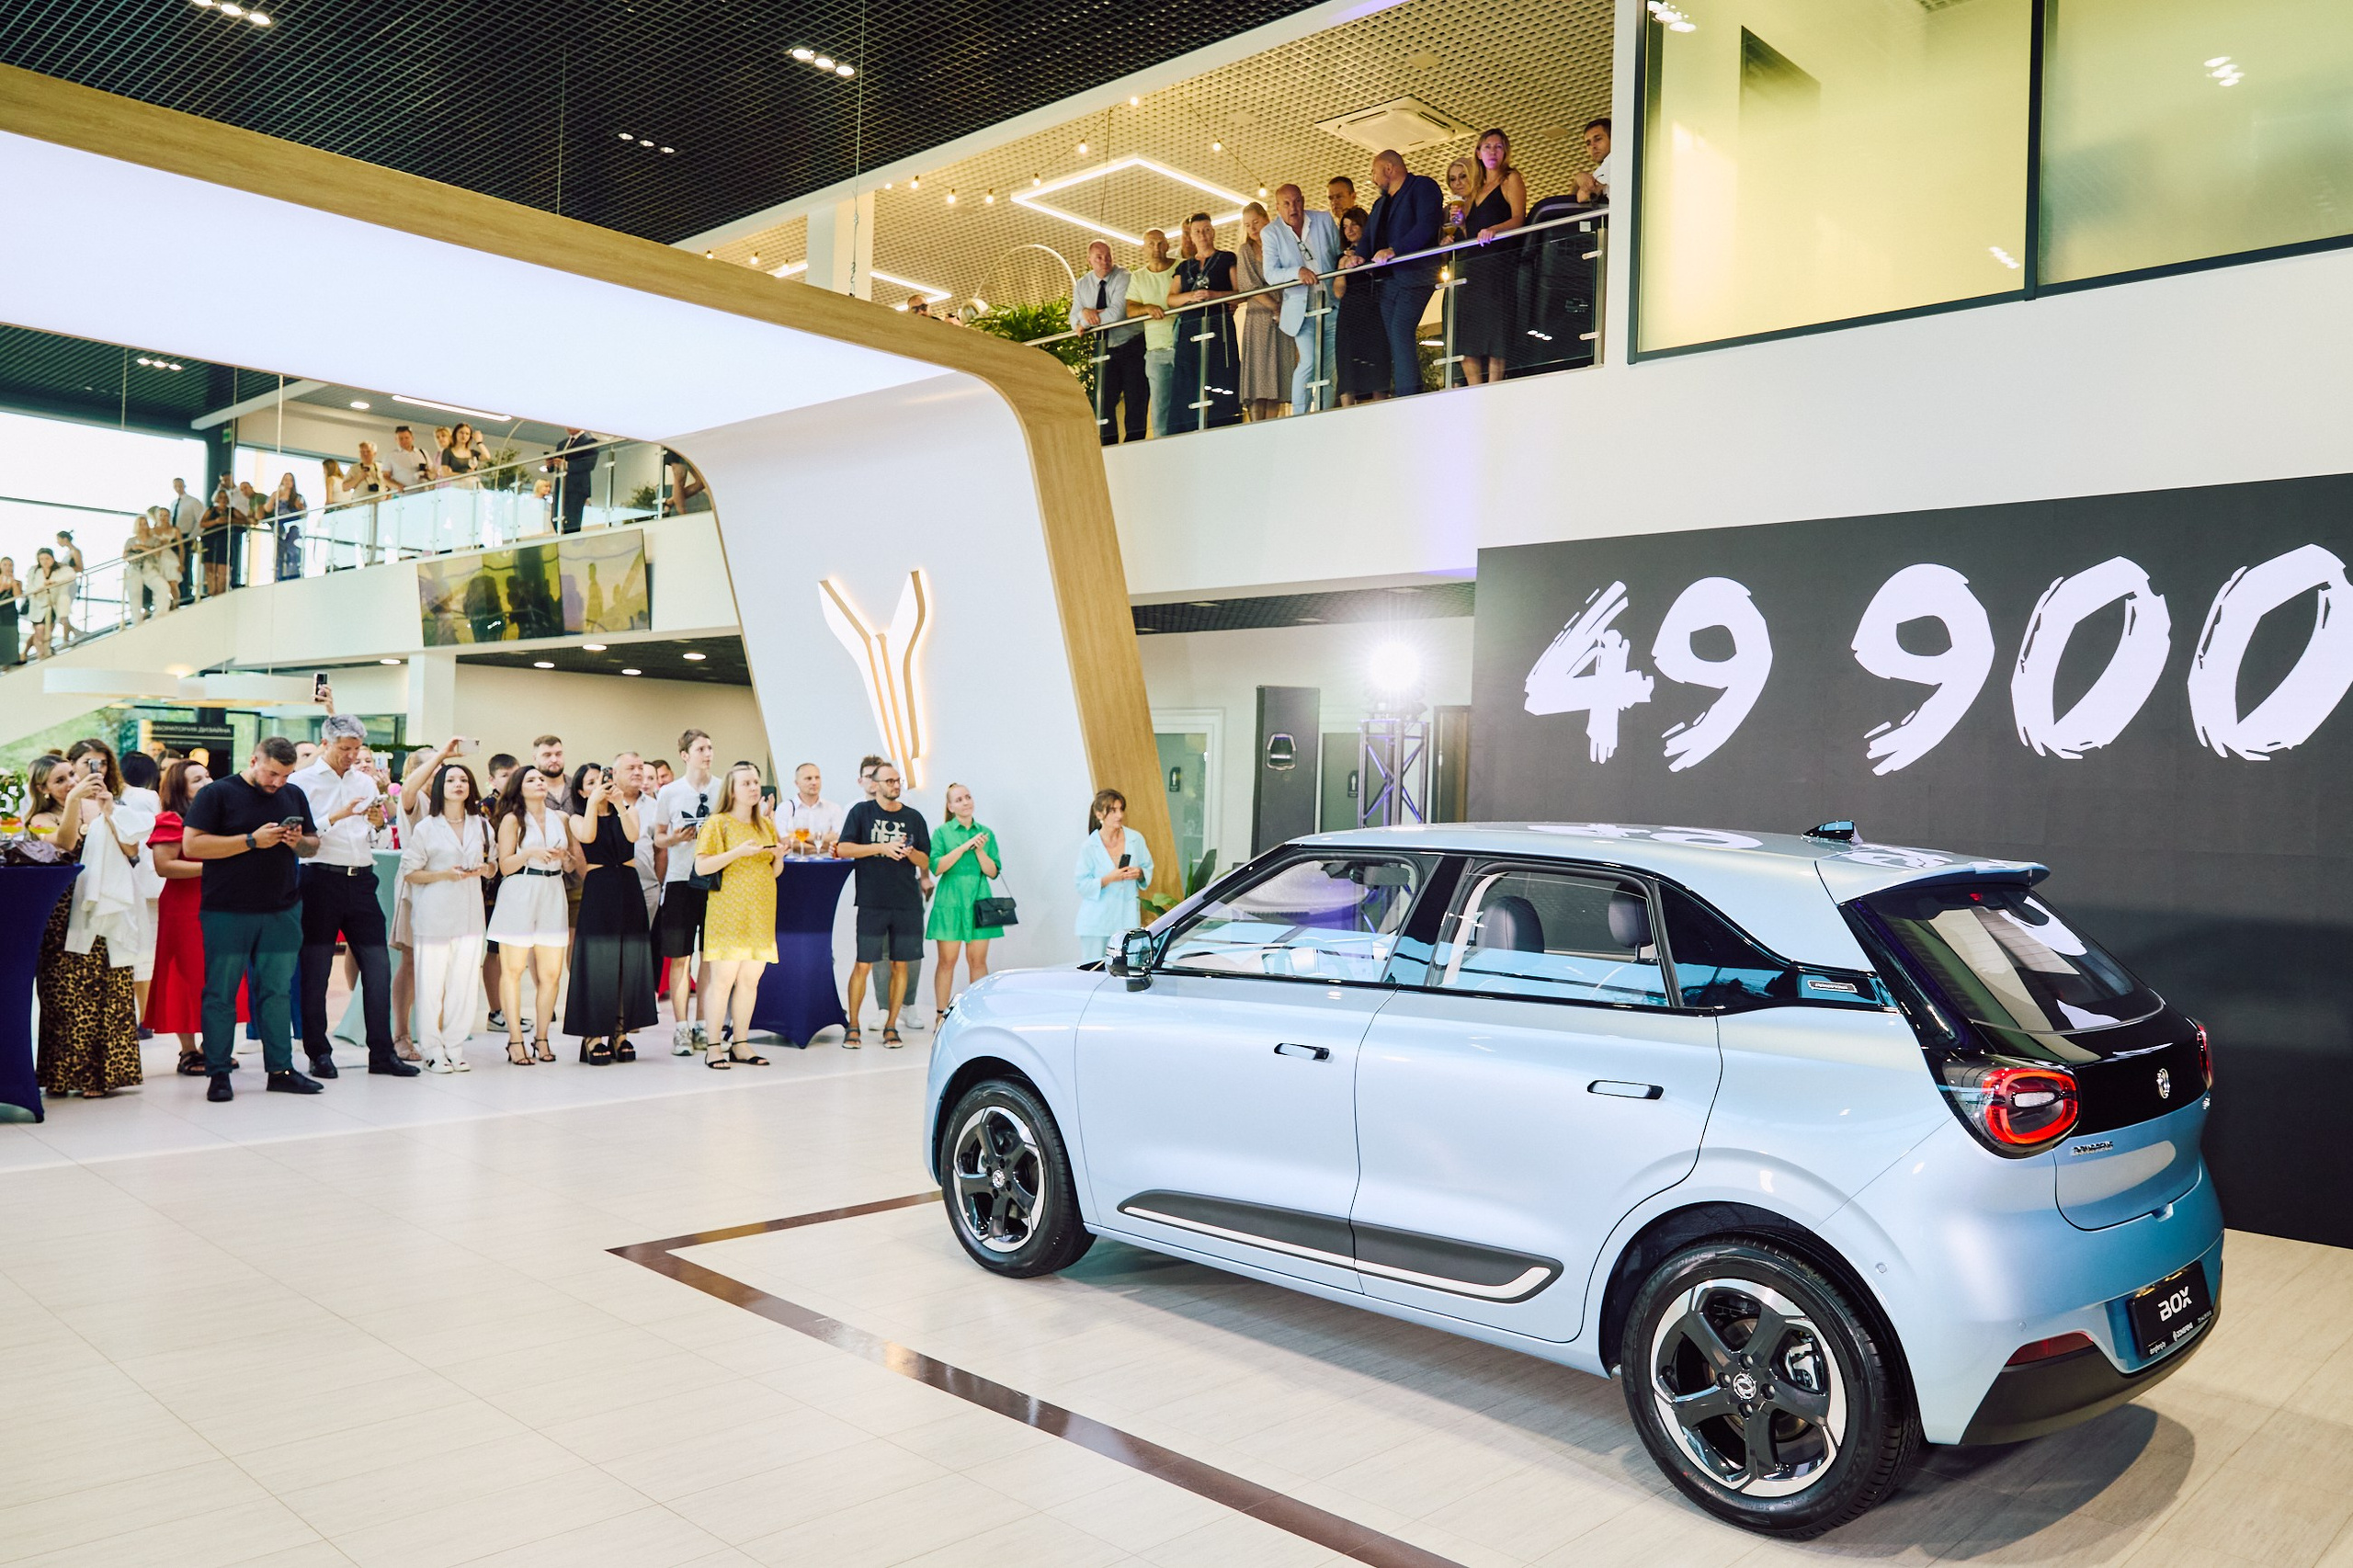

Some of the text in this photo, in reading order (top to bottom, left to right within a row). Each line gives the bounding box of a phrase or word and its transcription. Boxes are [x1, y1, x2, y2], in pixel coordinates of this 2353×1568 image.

[1524, 543, 2353, 777] 49 900
[198, 725, 231, 734] ДИЗАЙНА
[2157, 1286, 2193, 1322] BOX
